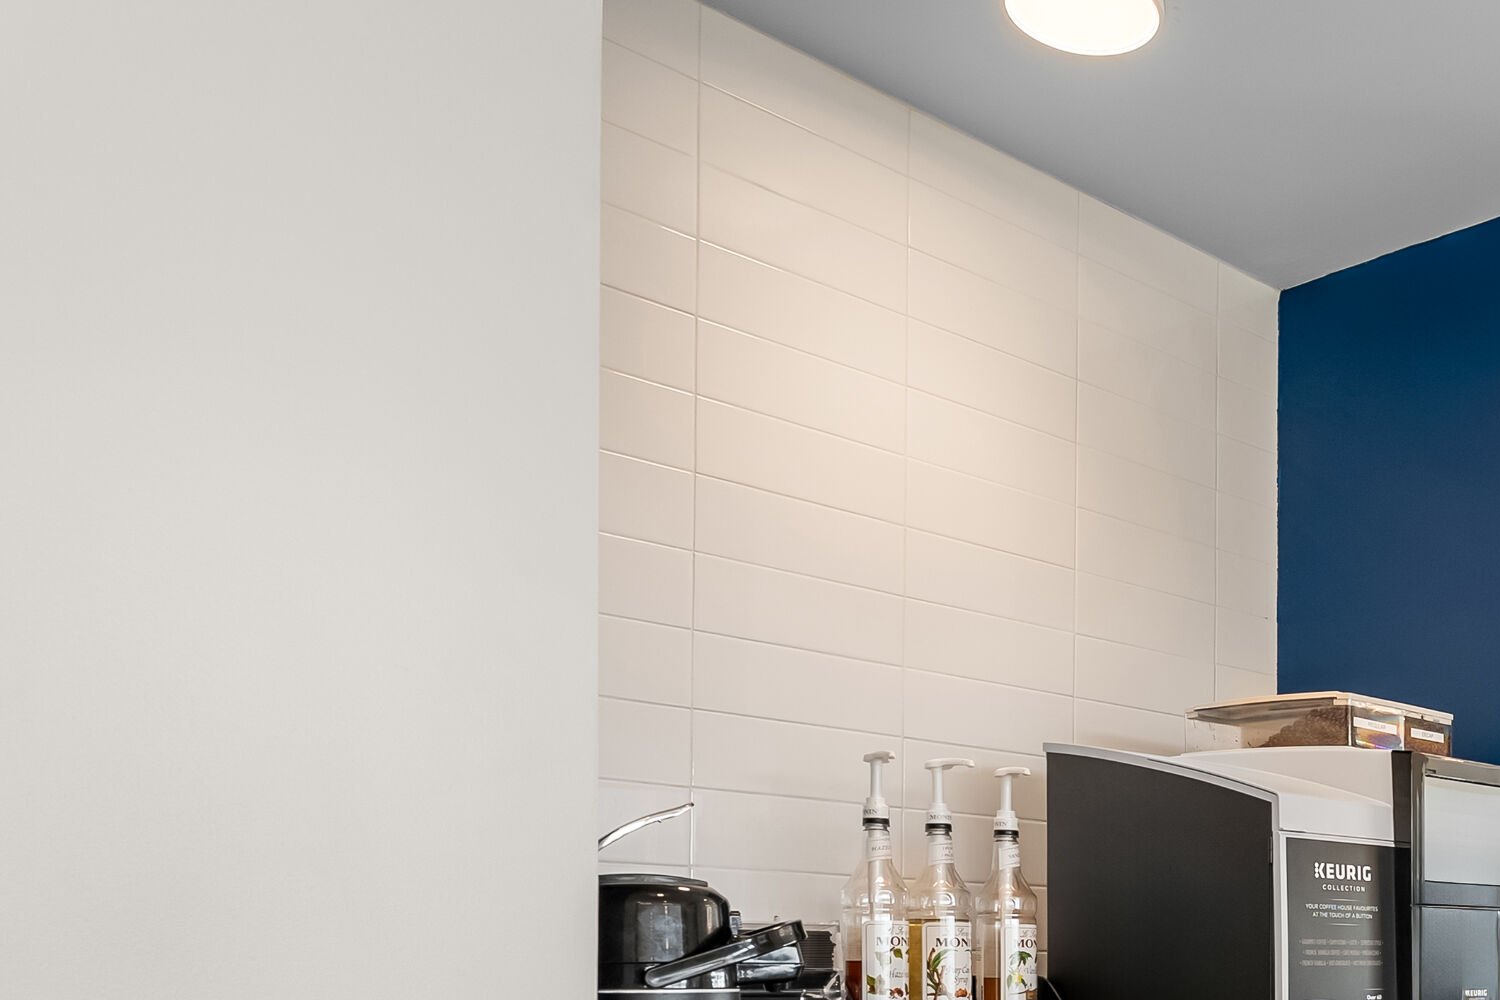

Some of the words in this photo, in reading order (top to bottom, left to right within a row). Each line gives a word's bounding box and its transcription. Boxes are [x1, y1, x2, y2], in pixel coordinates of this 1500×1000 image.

[1313, 862, 1372, 882] KEURIG
[1321, 884, 1366, 893] COLLECTION
[1464, 989, 1488, 997] KEURIG
